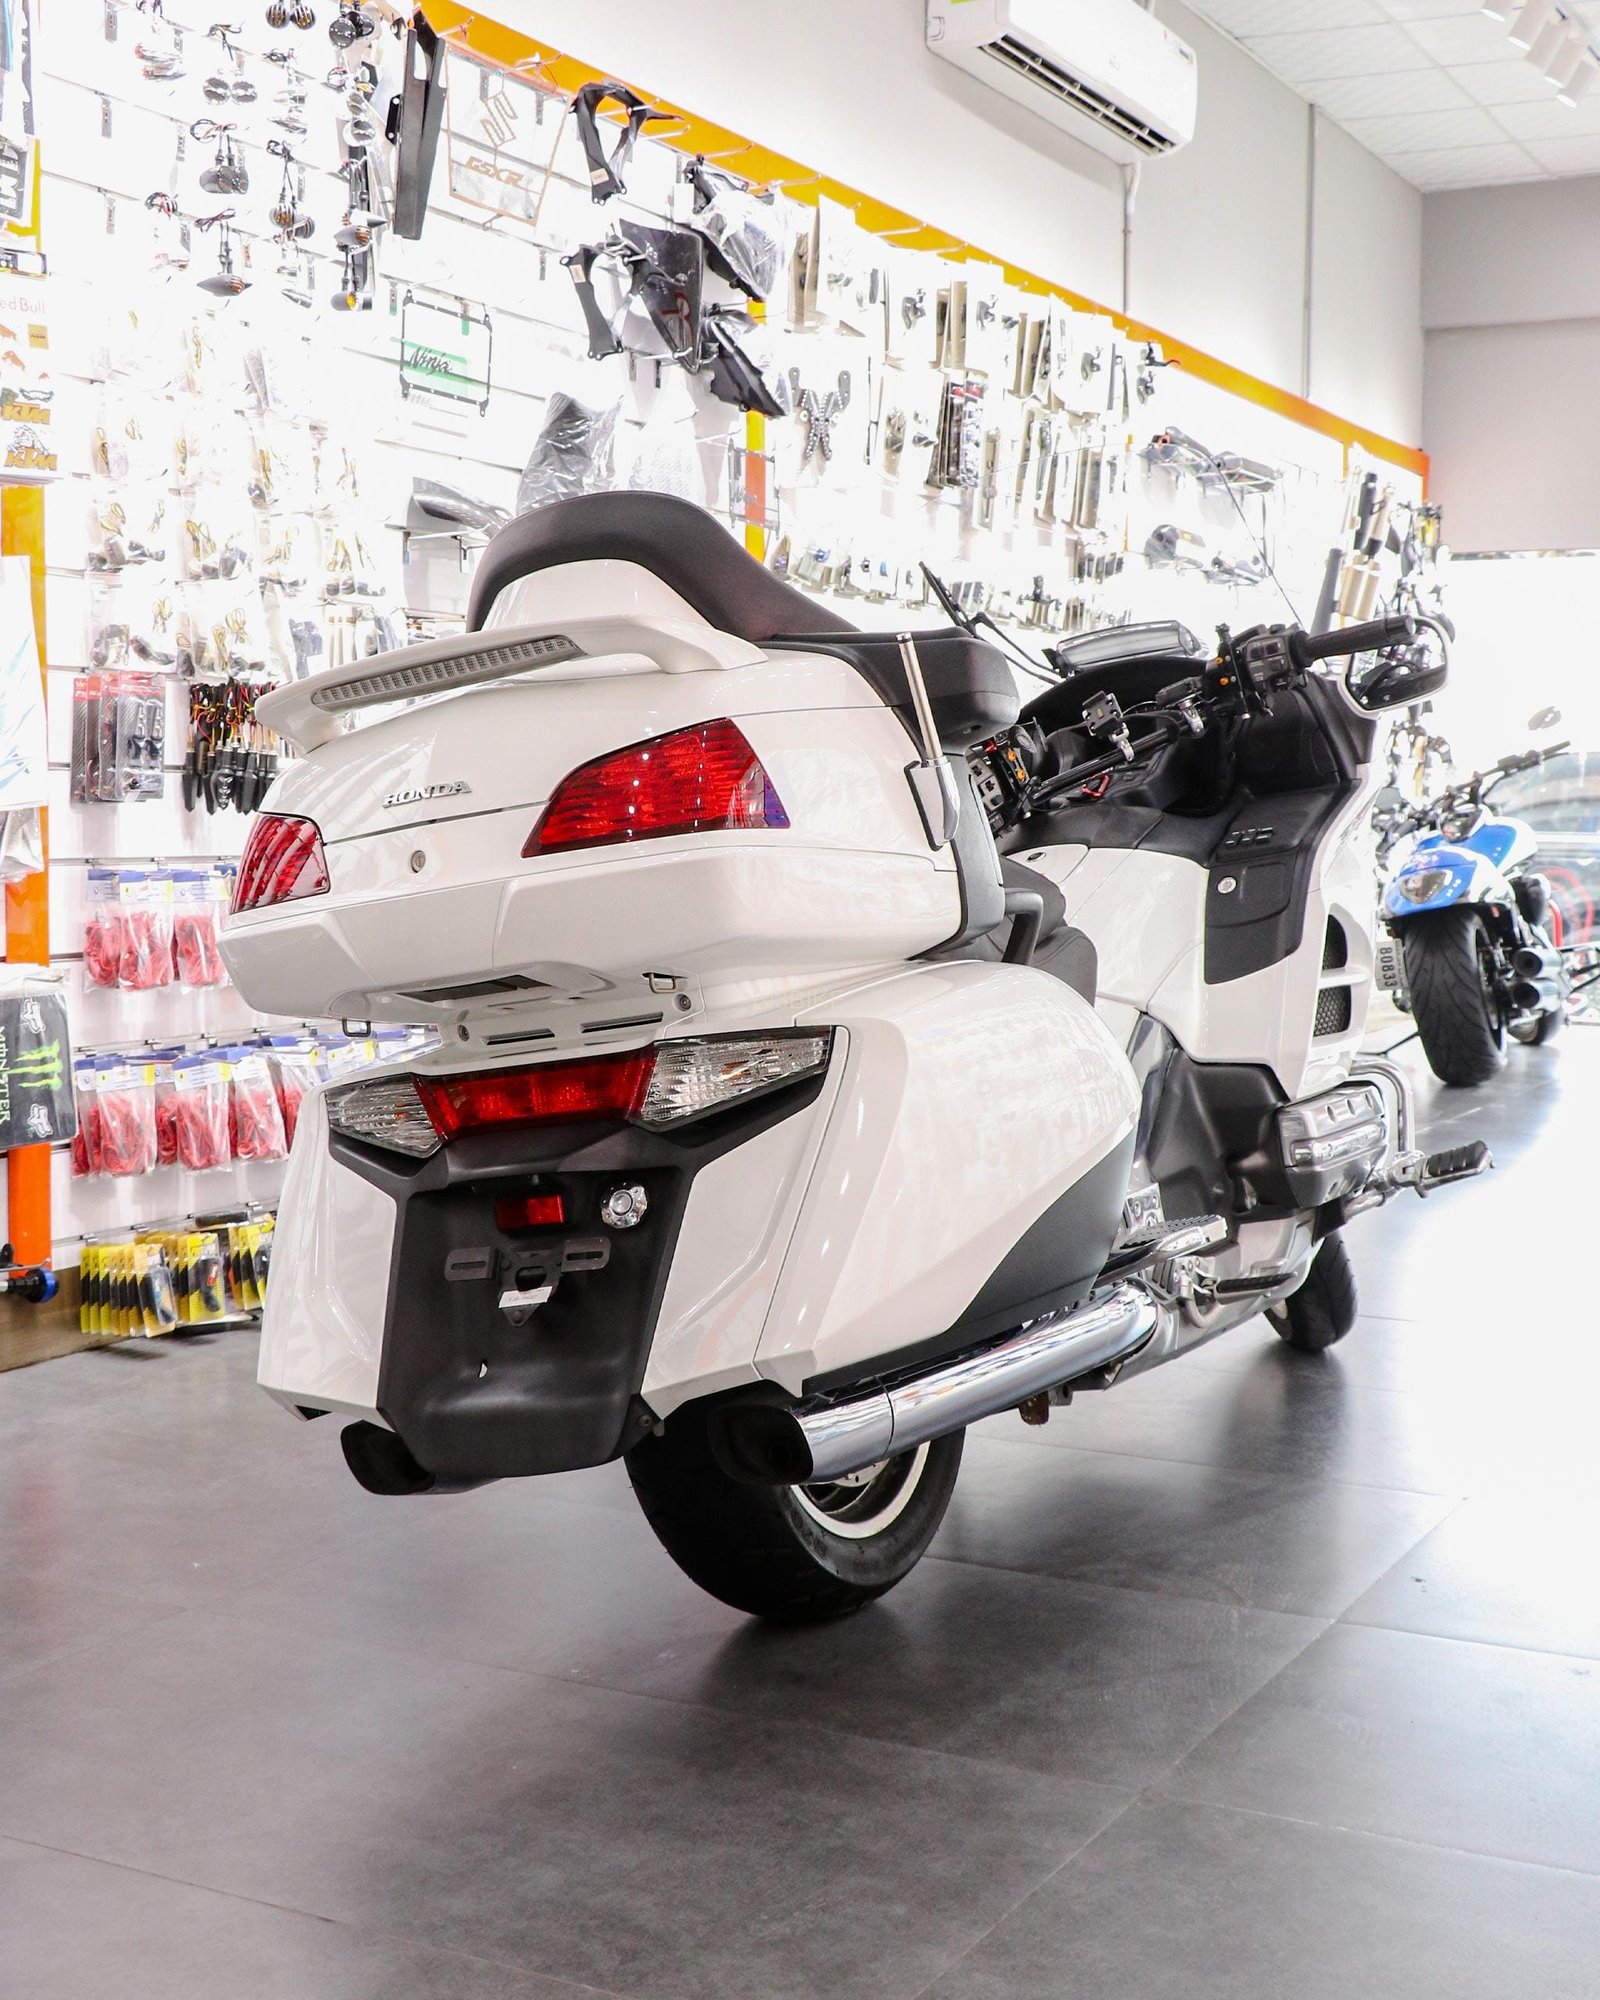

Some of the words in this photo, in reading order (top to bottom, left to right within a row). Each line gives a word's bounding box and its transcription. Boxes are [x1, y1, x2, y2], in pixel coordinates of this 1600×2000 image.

[0, 296, 16, 310] ed
[20, 297, 46, 314] Bull
[409, 346, 451, 376] Ninja
[1, 401, 50, 425] KTM
[4, 447, 57, 471] KTM
[382, 780, 471, 808] HONDA
[1380, 947, 1398, 987] 80833
